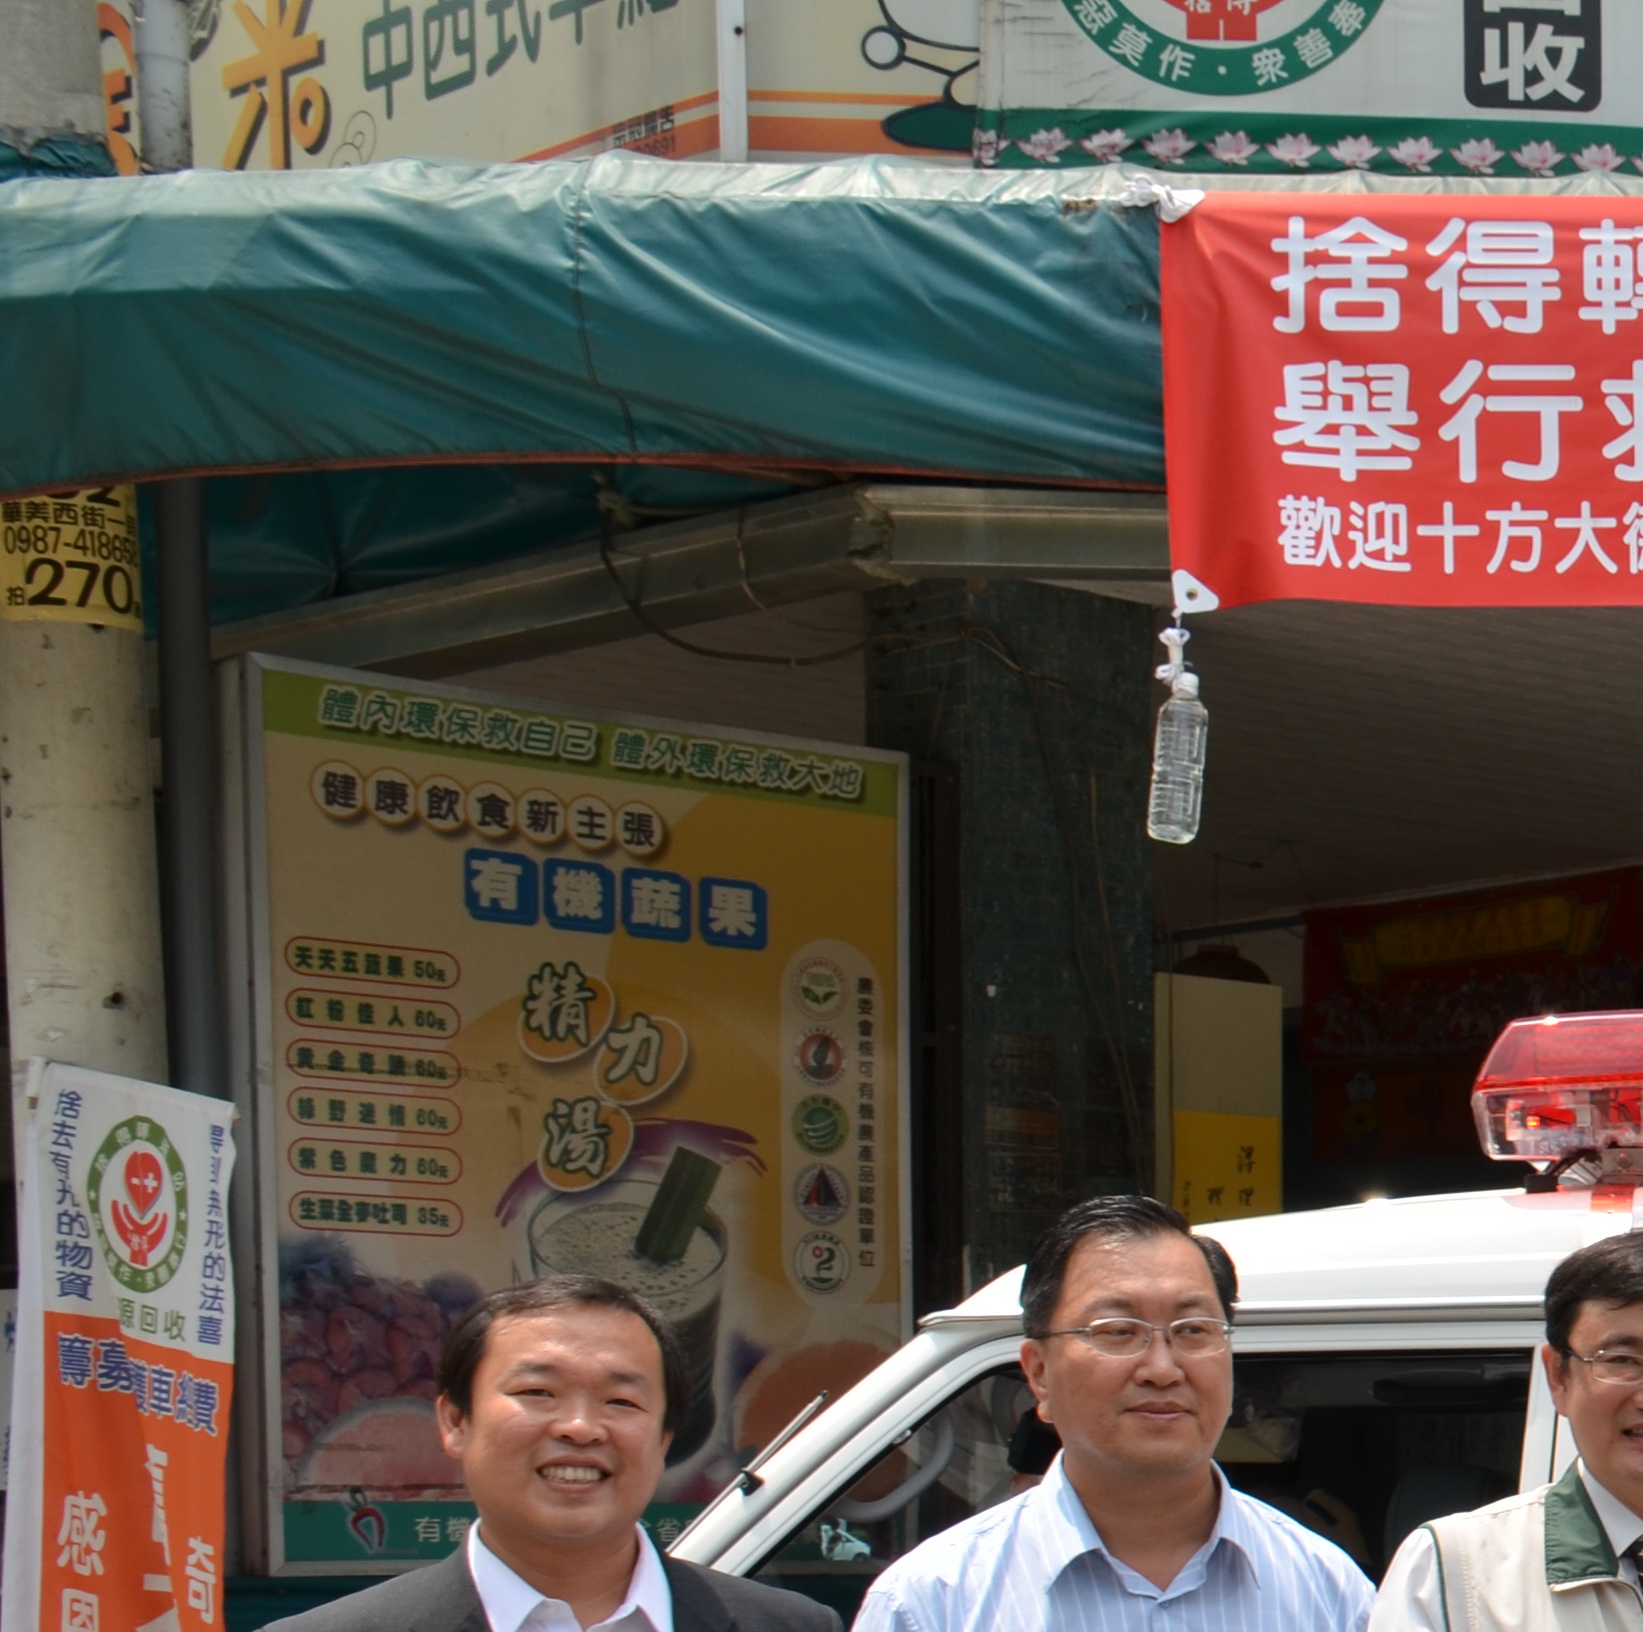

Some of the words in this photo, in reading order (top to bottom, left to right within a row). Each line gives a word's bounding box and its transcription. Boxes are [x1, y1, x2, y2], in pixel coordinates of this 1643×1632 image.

[319, 769, 656, 850] 健康飲食新主張
[469, 856, 758, 939] 有機蔬果
